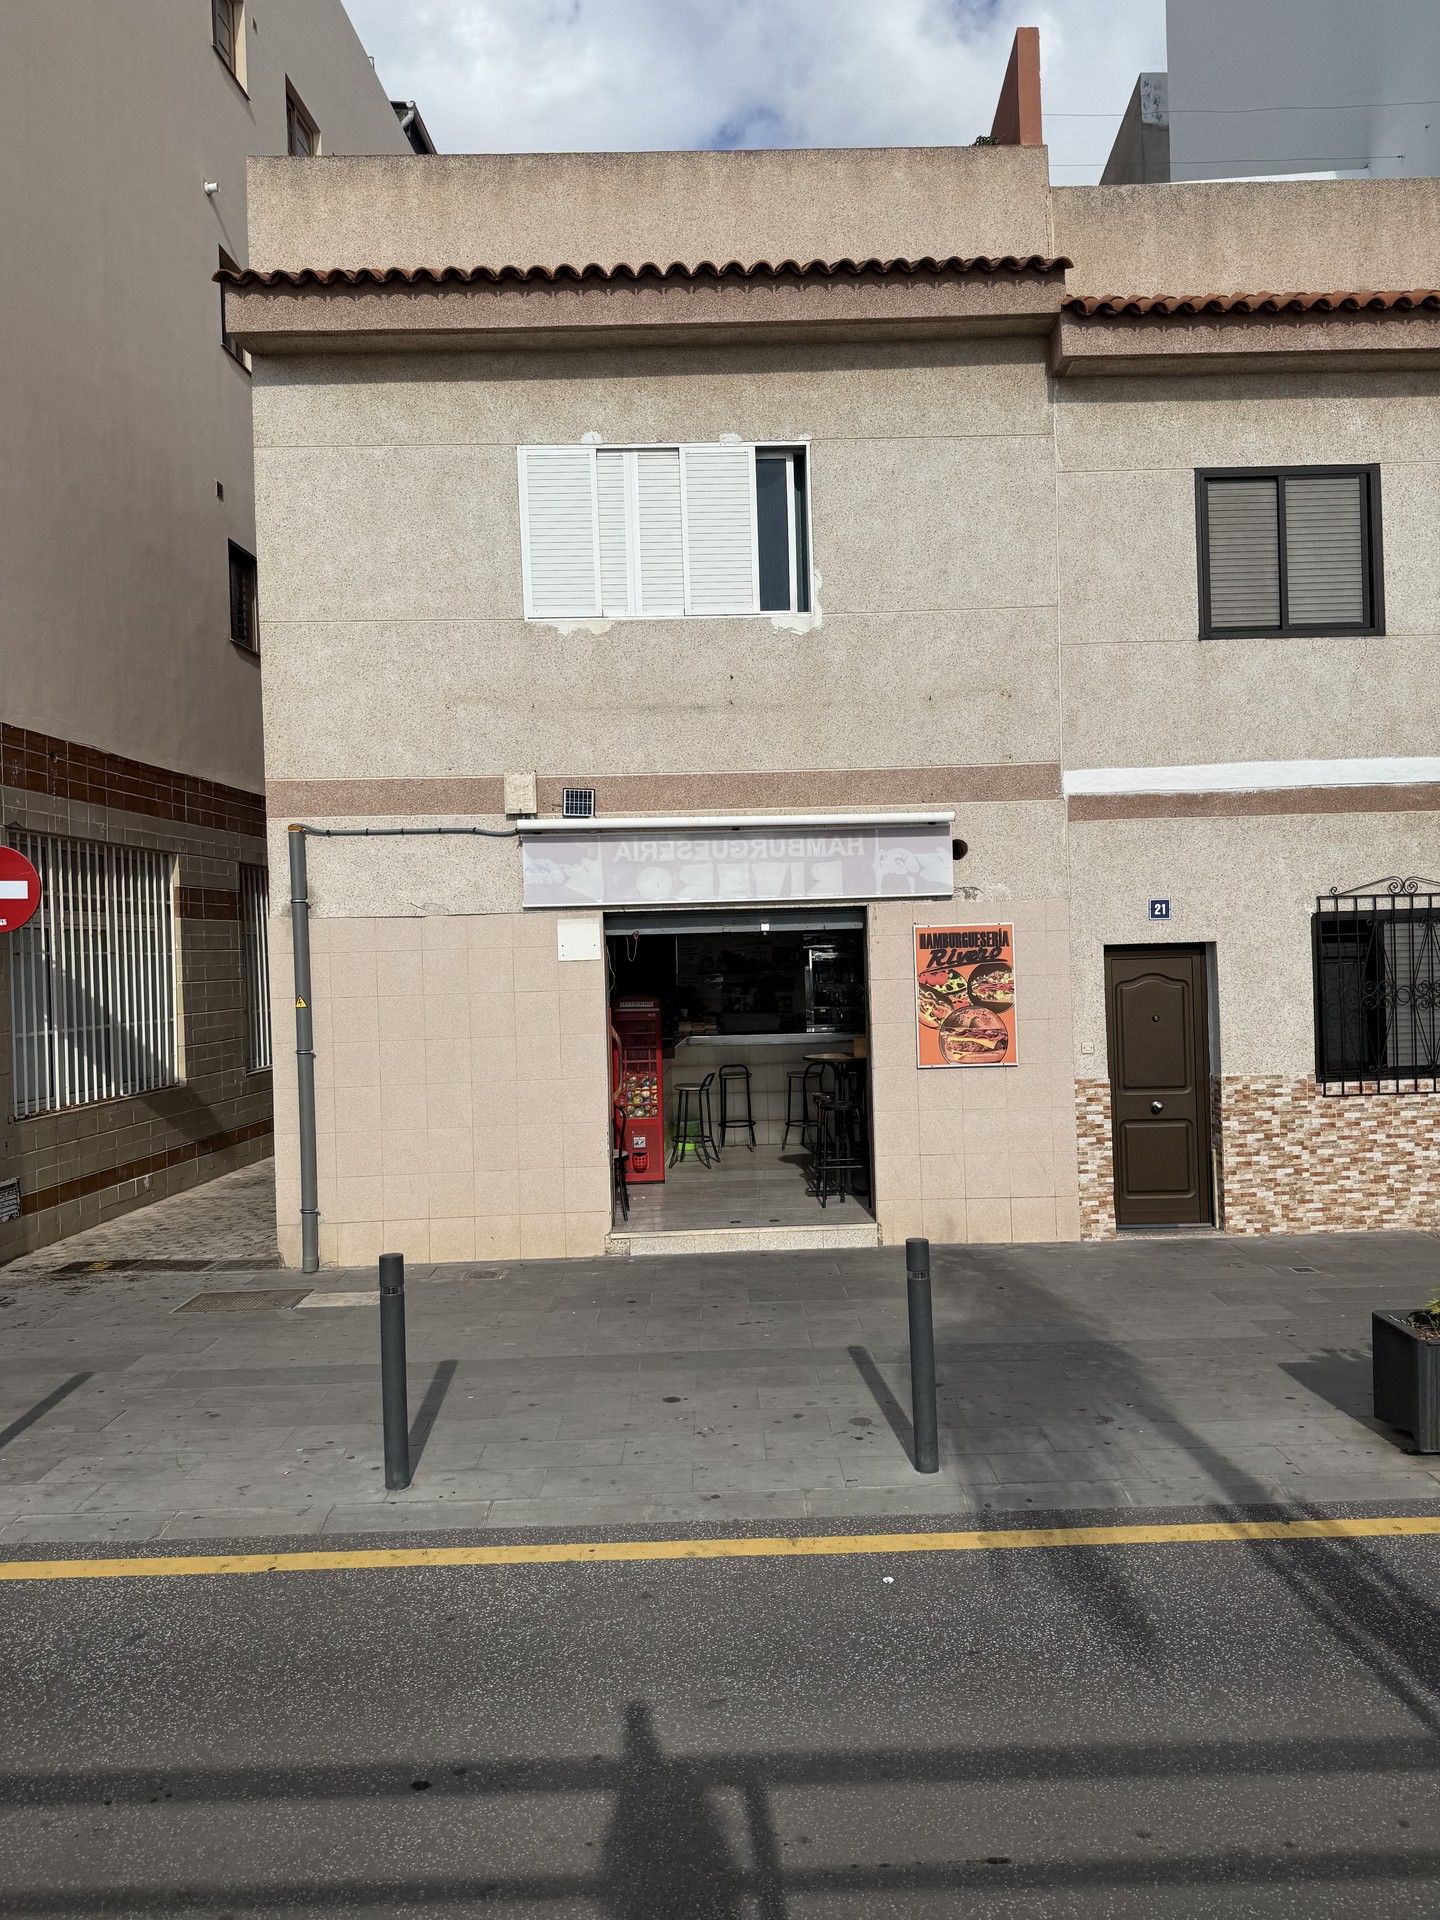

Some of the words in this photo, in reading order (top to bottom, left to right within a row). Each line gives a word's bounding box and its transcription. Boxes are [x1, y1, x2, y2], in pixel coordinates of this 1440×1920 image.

[1154, 903, 1166, 915] 21
[919, 928, 1009, 949] HAMBURGUESERÍA
[926, 946, 1002, 968] Rivero
